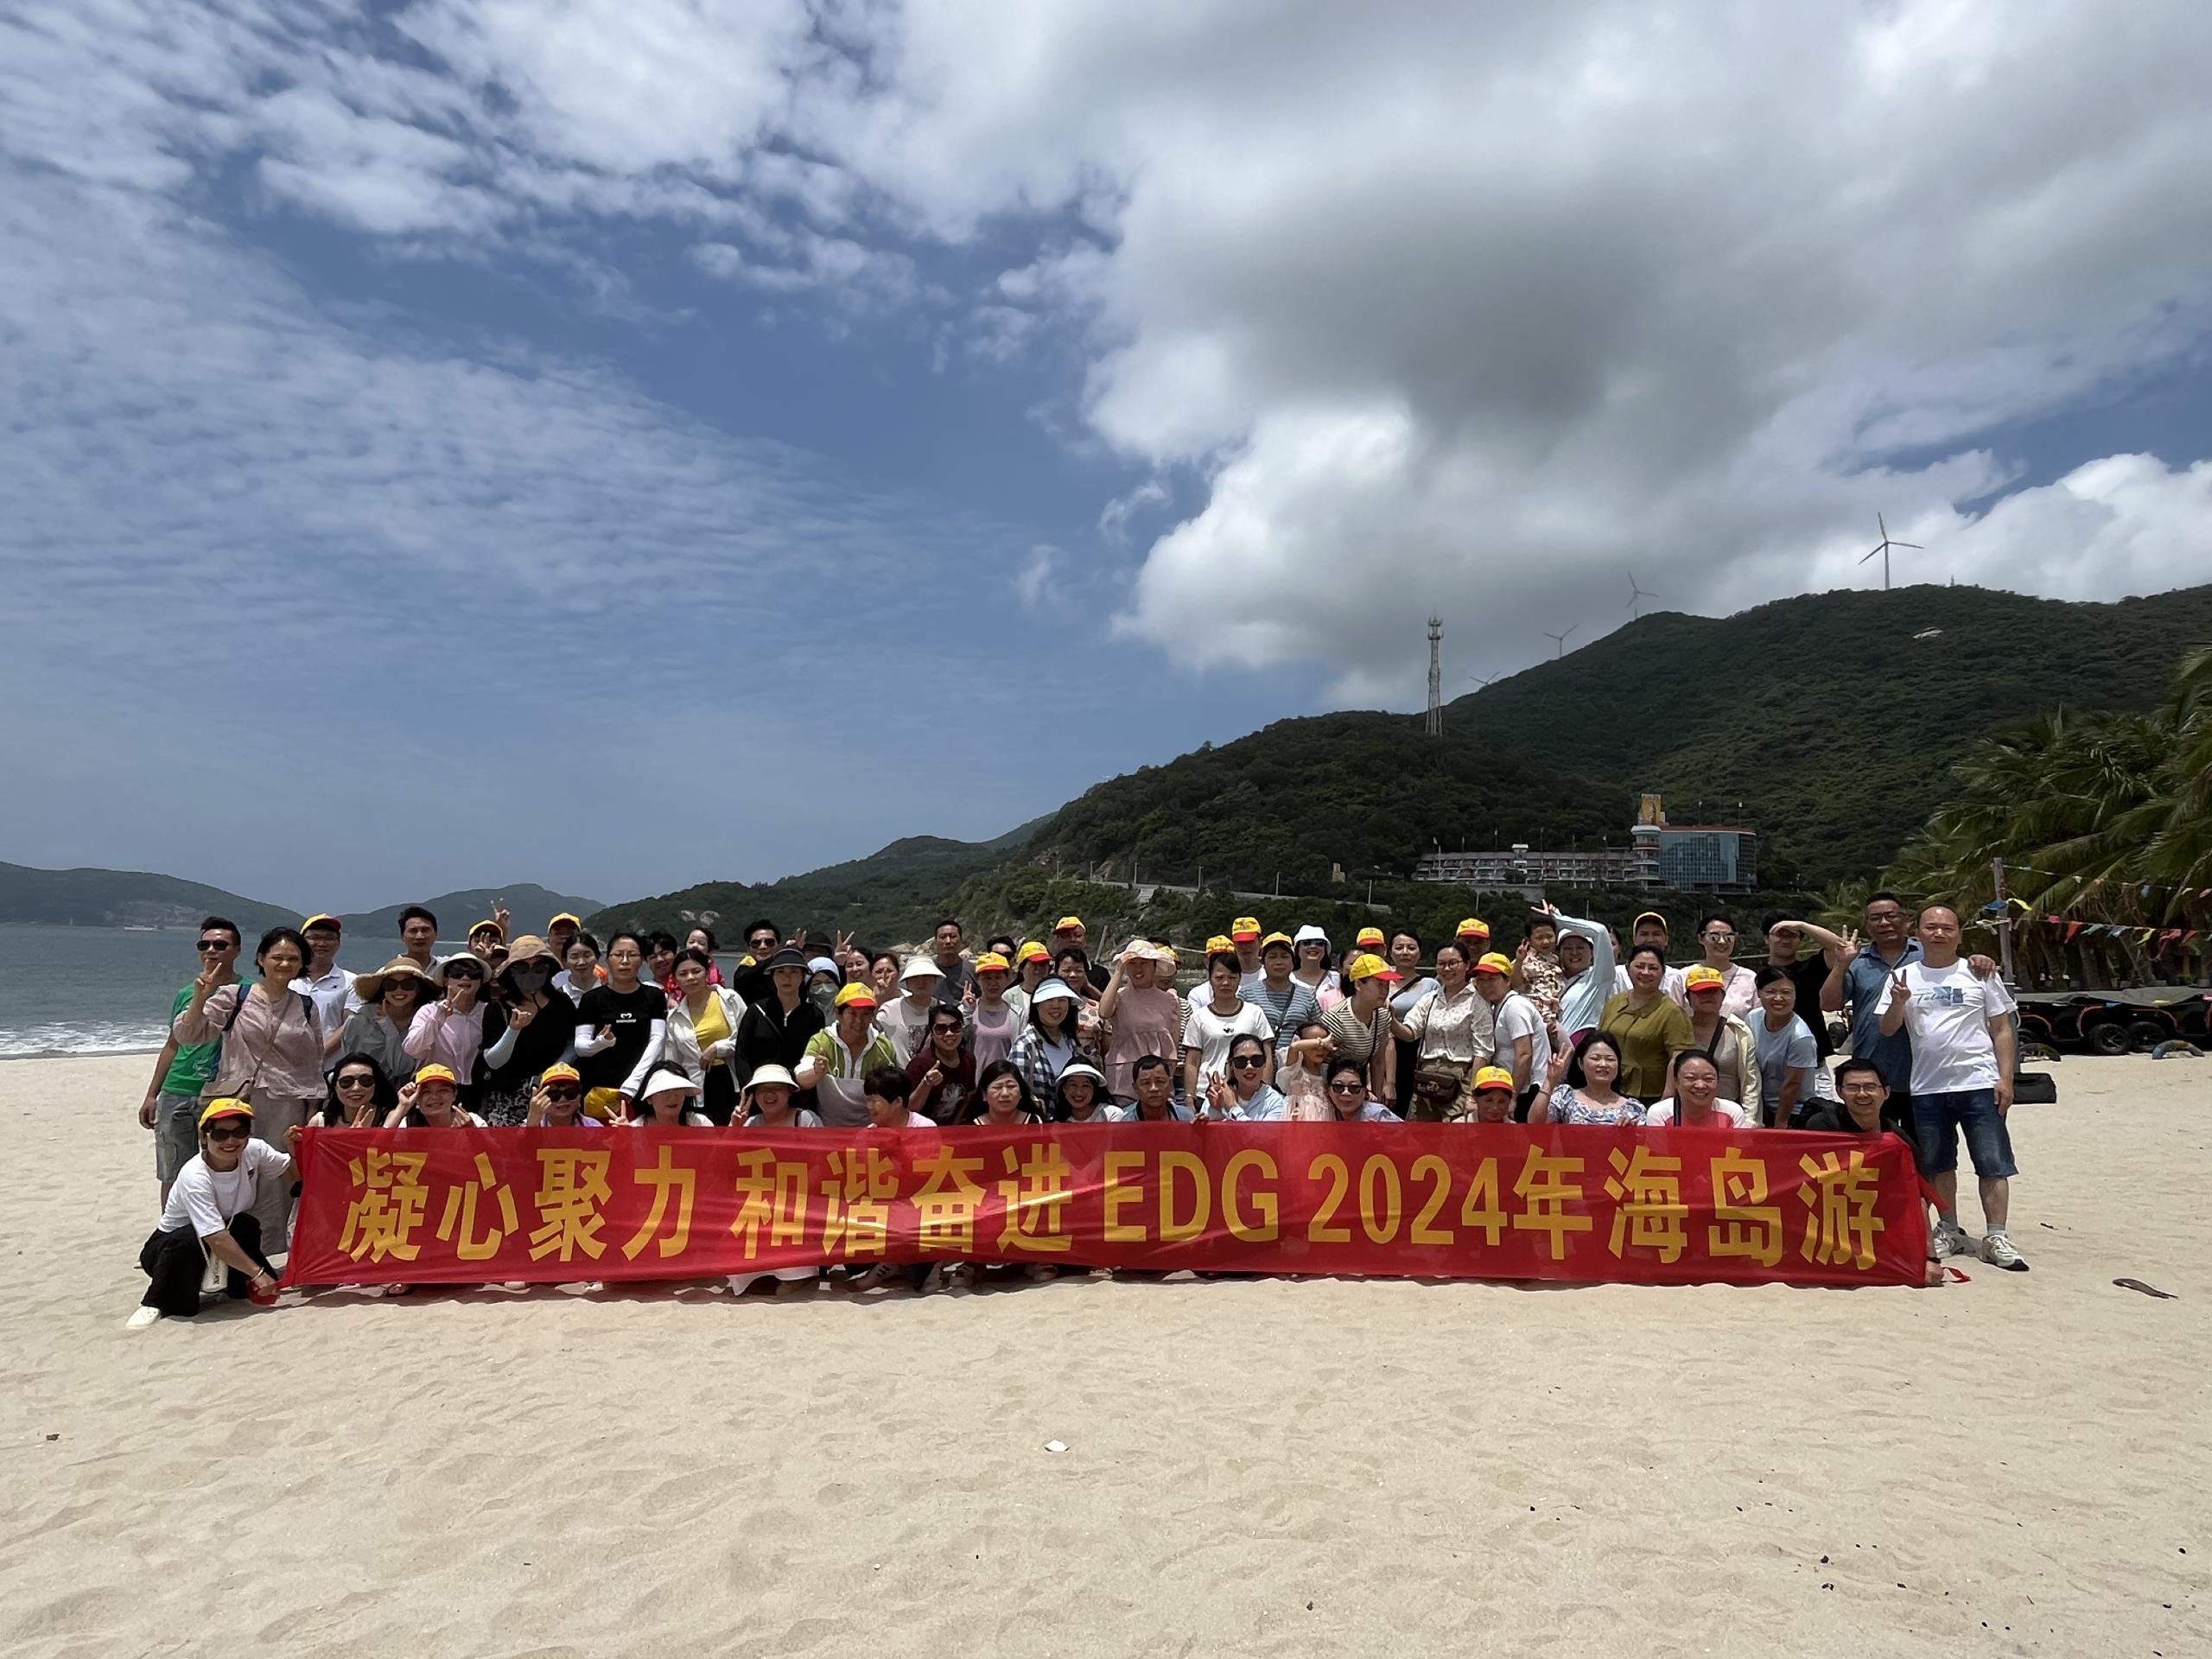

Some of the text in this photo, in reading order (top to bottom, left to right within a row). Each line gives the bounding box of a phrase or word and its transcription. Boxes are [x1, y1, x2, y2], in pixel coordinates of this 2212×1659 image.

[338, 1144, 1885, 1270] 凝心聚力 和谐奋进 EDG 2024年海岛游
